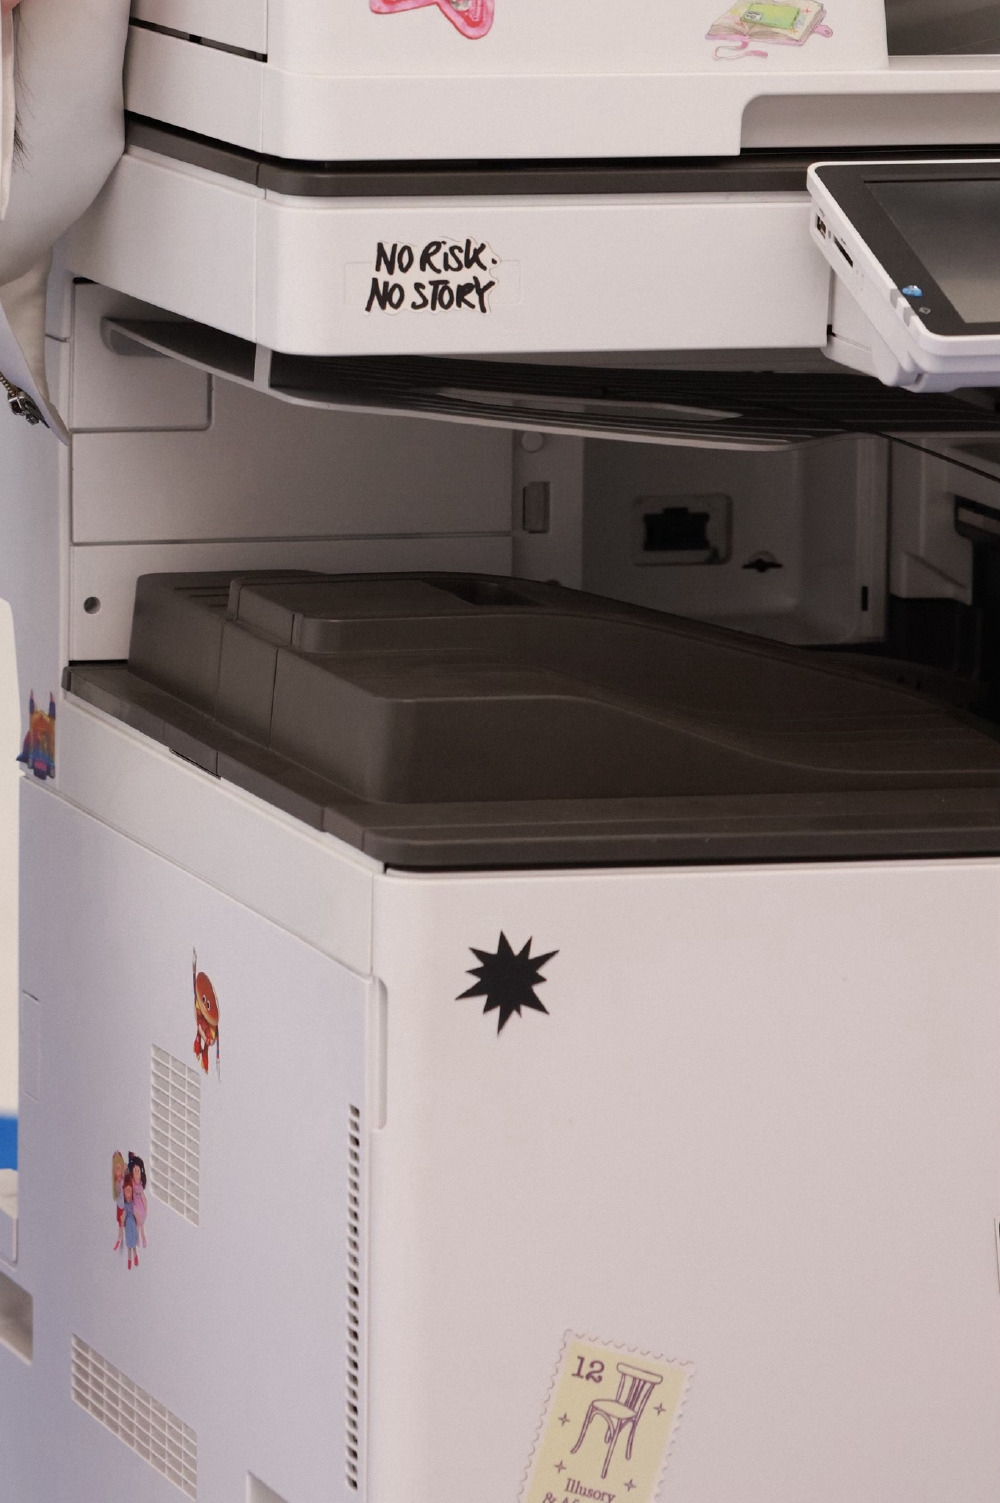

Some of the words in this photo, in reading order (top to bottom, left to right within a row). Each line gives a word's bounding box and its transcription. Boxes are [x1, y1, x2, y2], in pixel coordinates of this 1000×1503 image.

[375, 242, 414, 275] NO
[365, 277, 405, 312] NO
[411, 276, 495, 313] STORY
[571, 1355, 605, 1383] 12
[564, 1478, 616, 1503] Illusory
